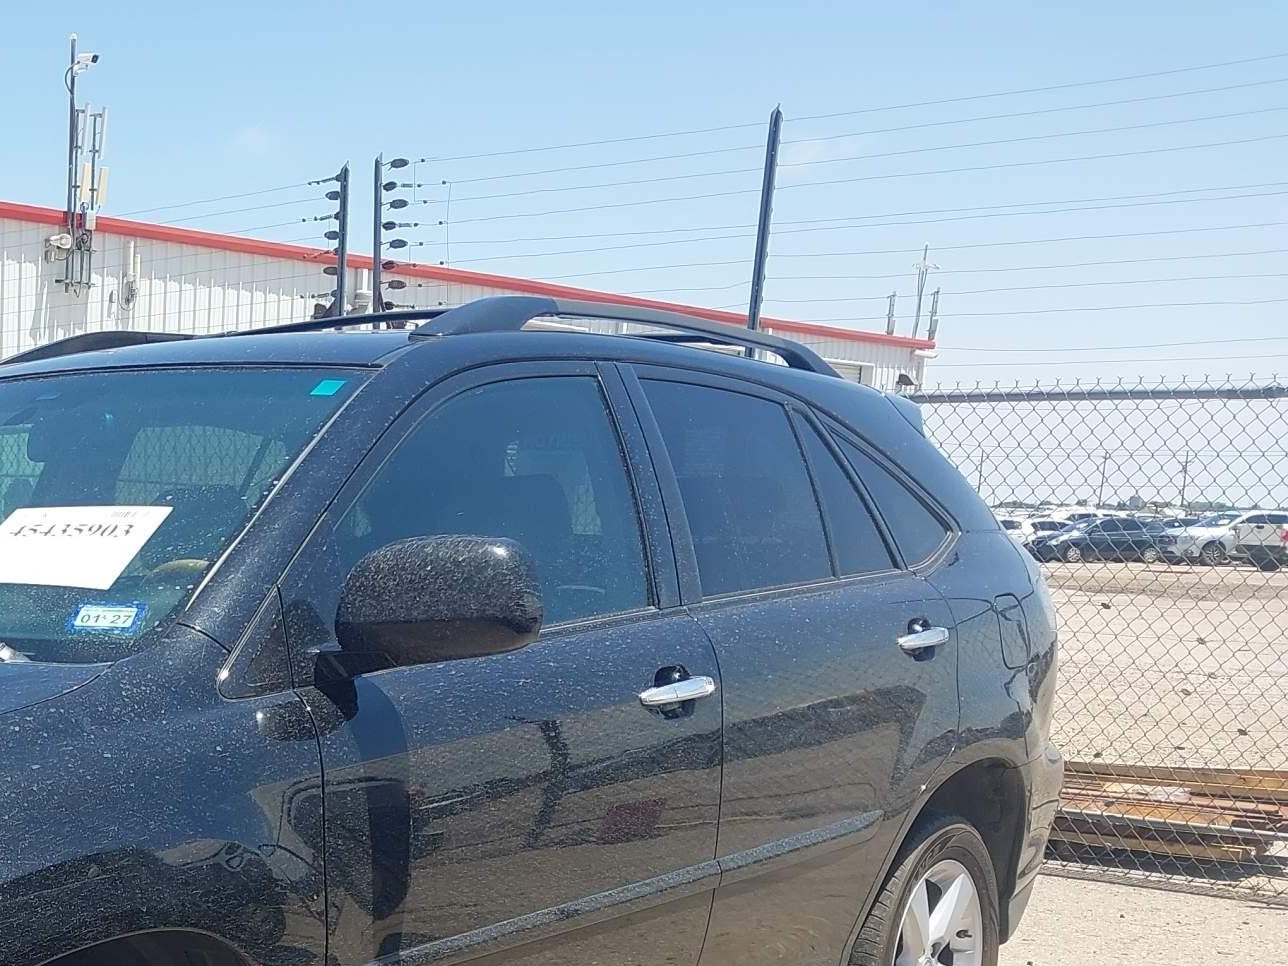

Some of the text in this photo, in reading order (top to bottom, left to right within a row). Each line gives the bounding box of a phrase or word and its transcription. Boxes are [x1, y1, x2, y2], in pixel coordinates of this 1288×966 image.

[10, 523, 134, 538] 45435903
[80, 614, 133, 625] 01 27
